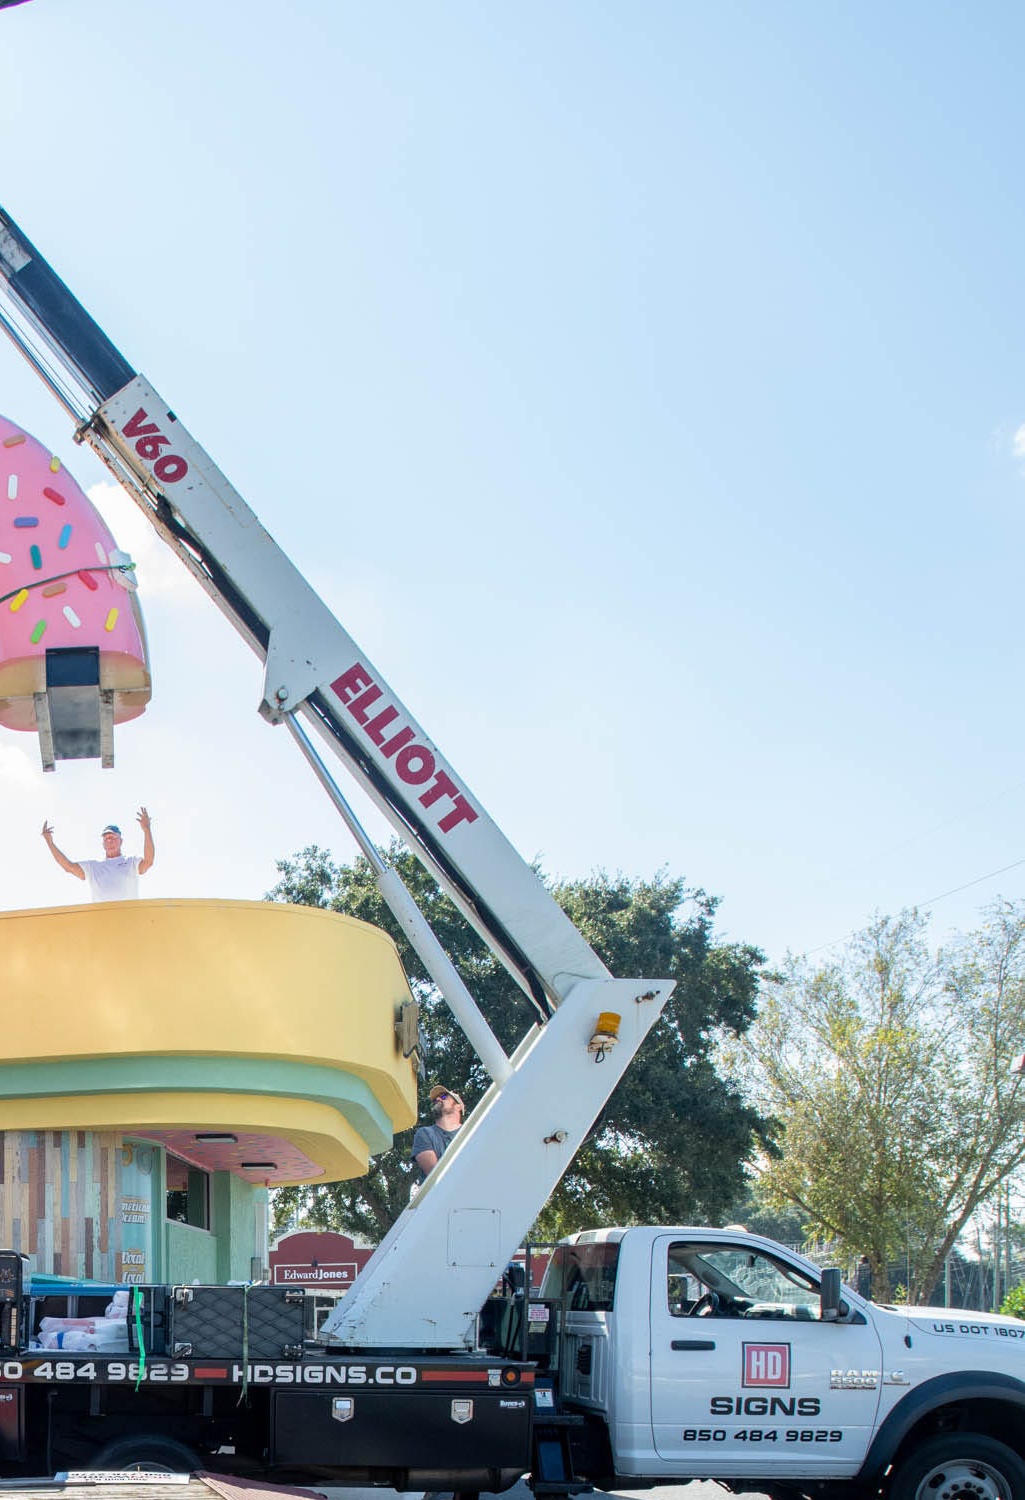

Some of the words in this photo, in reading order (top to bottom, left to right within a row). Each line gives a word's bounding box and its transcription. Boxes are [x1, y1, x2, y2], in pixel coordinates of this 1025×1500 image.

[121, 407, 188, 483] V60
[329, 662, 479, 833] ELLIOTT
[933, 1324, 954, 1333] US
[959, 1325, 989, 1335] DOT
[33, 1362, 97, 1380] 484
[107, 1362, 189, 1381] 9829
[232, 1365, 417, 1385] HDSIGNS.CO
[750, 1350, 782, 1381] HD
[710, 1396, 821, 1416] SIGNS
[683, 1429, 726, 1442] 850
[733, 1430, 778, 1442] 484
[785, 1430, 843, 1443] 9829
